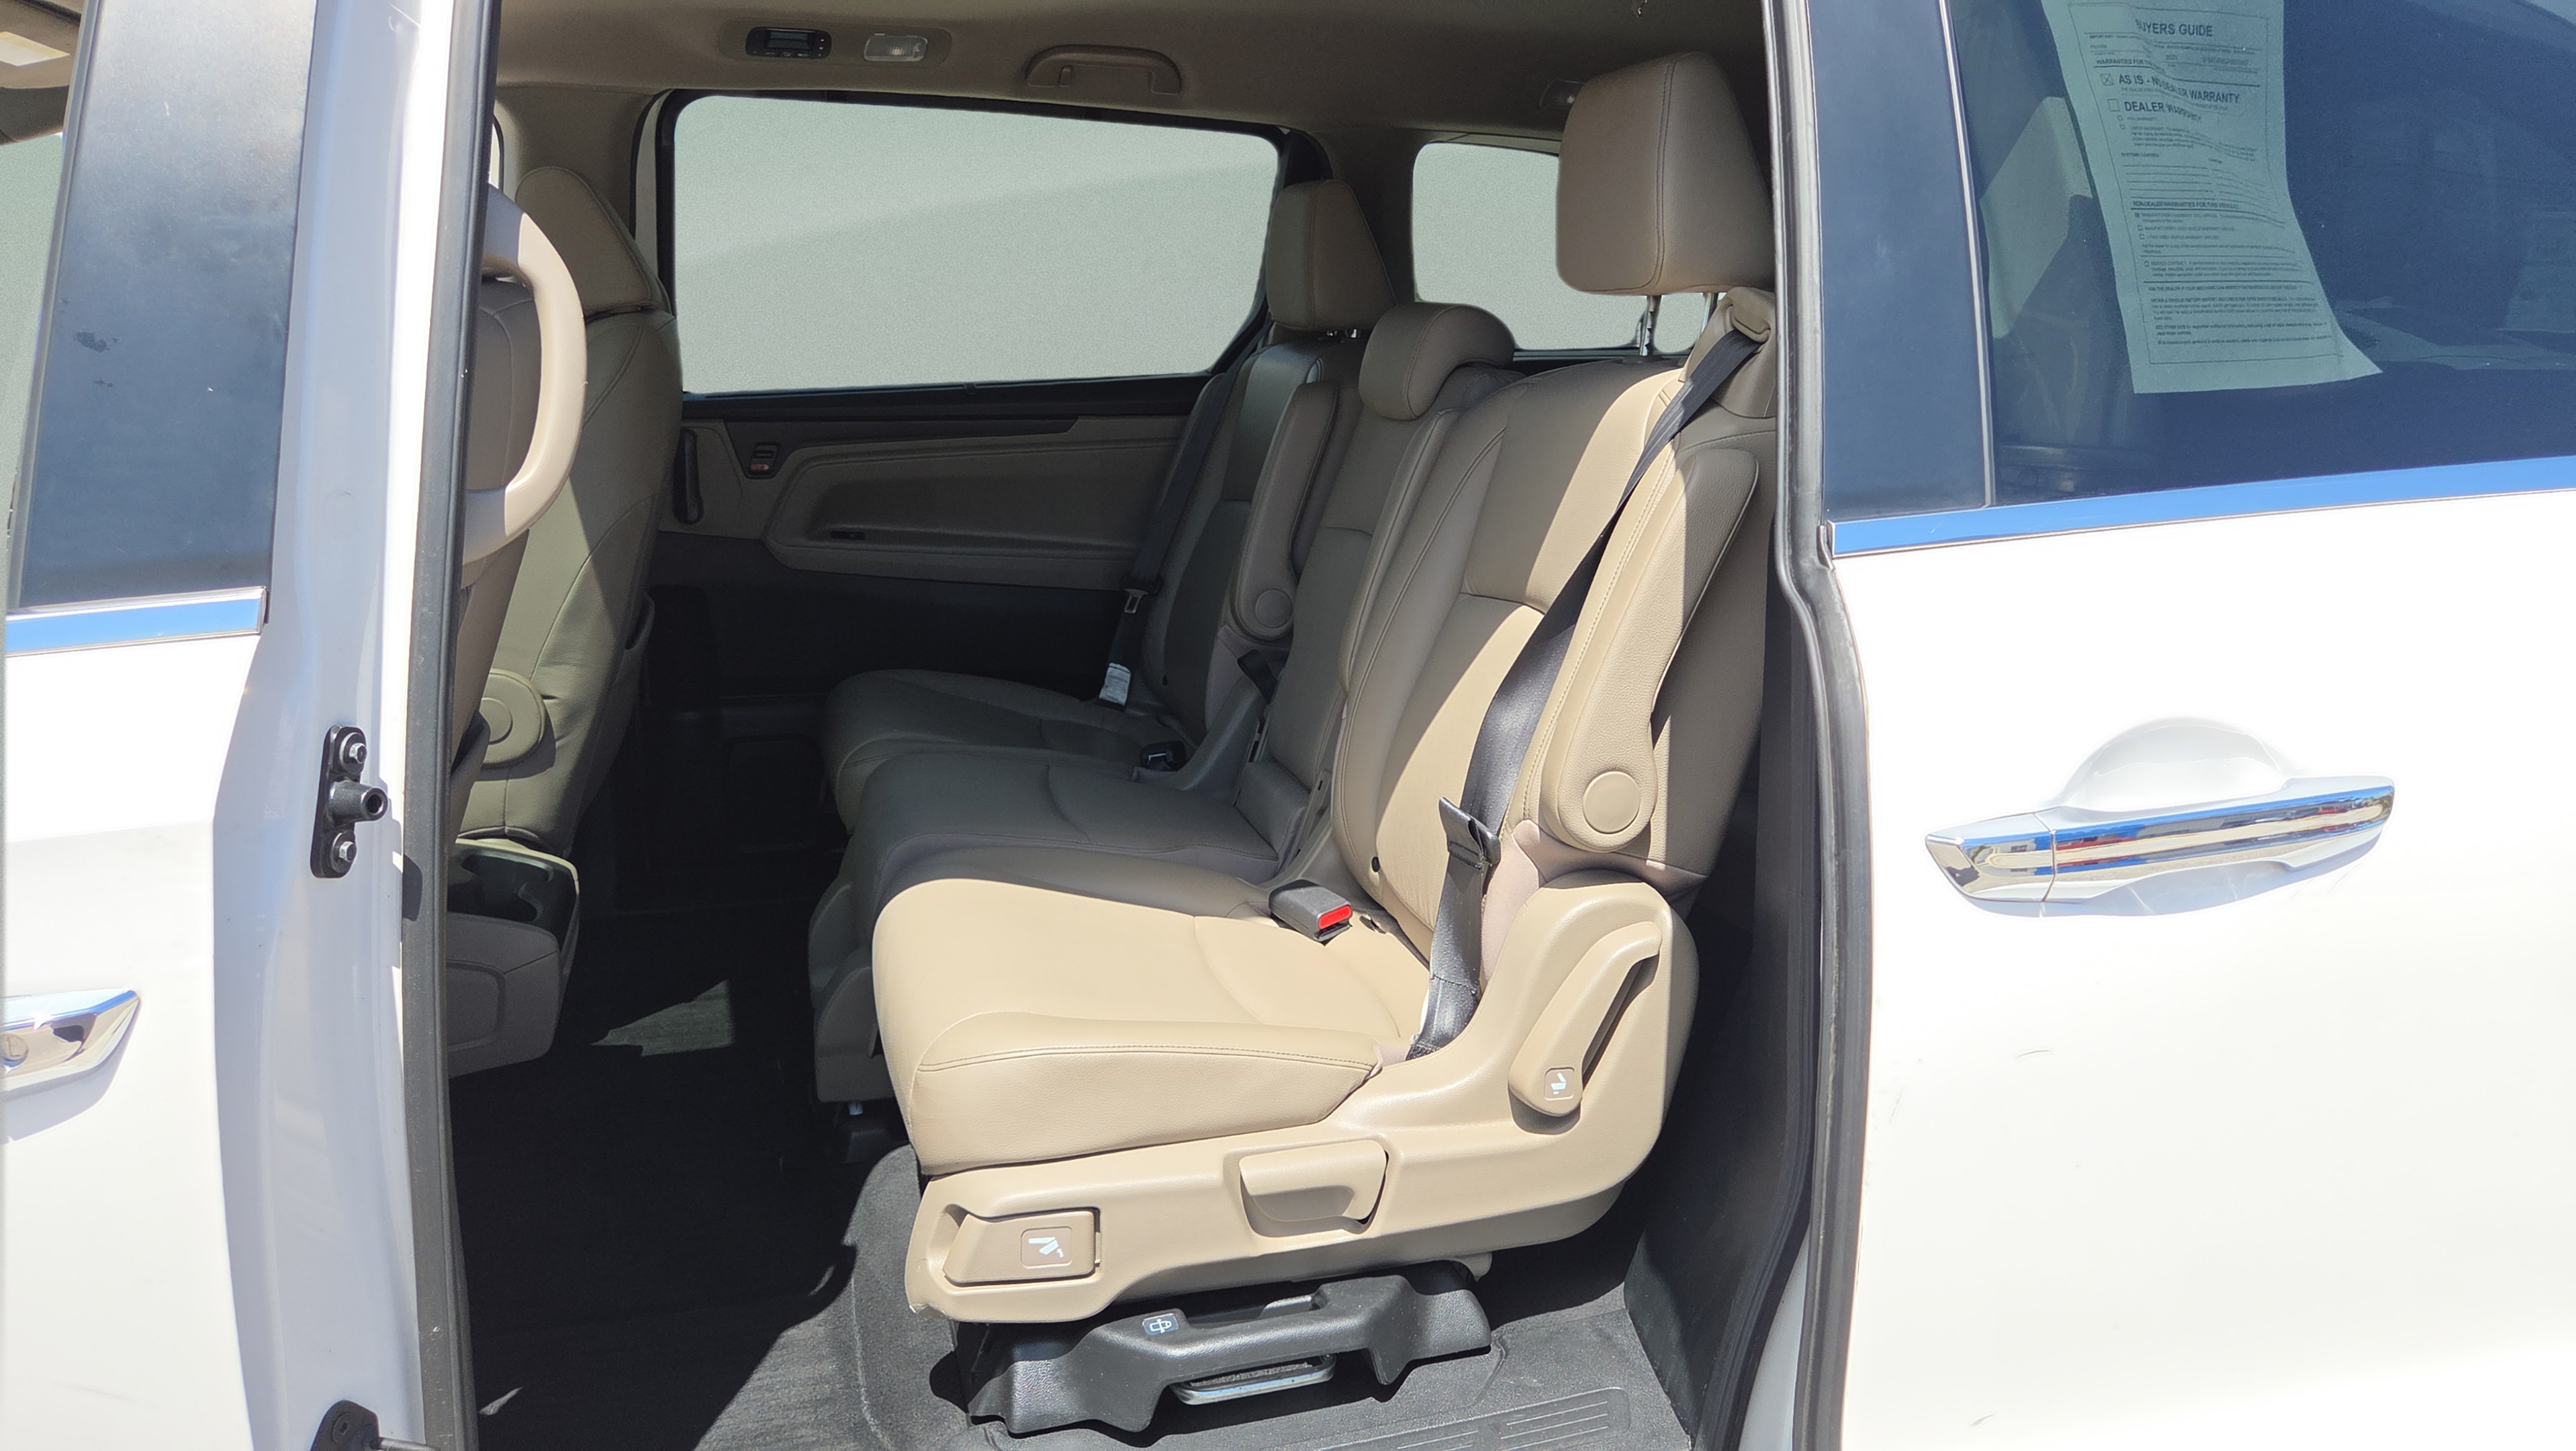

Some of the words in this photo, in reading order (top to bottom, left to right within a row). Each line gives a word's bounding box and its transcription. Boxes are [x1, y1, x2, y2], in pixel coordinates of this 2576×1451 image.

[2178, 23, 2213, 37] GUIDE
[2119, 74, 2131, 85] AS
[2133, 75, 2144, 85] IS
[2189, 89, 2240, 105] WARRANTY
[2124, 101, 2165, 113] DEALER
